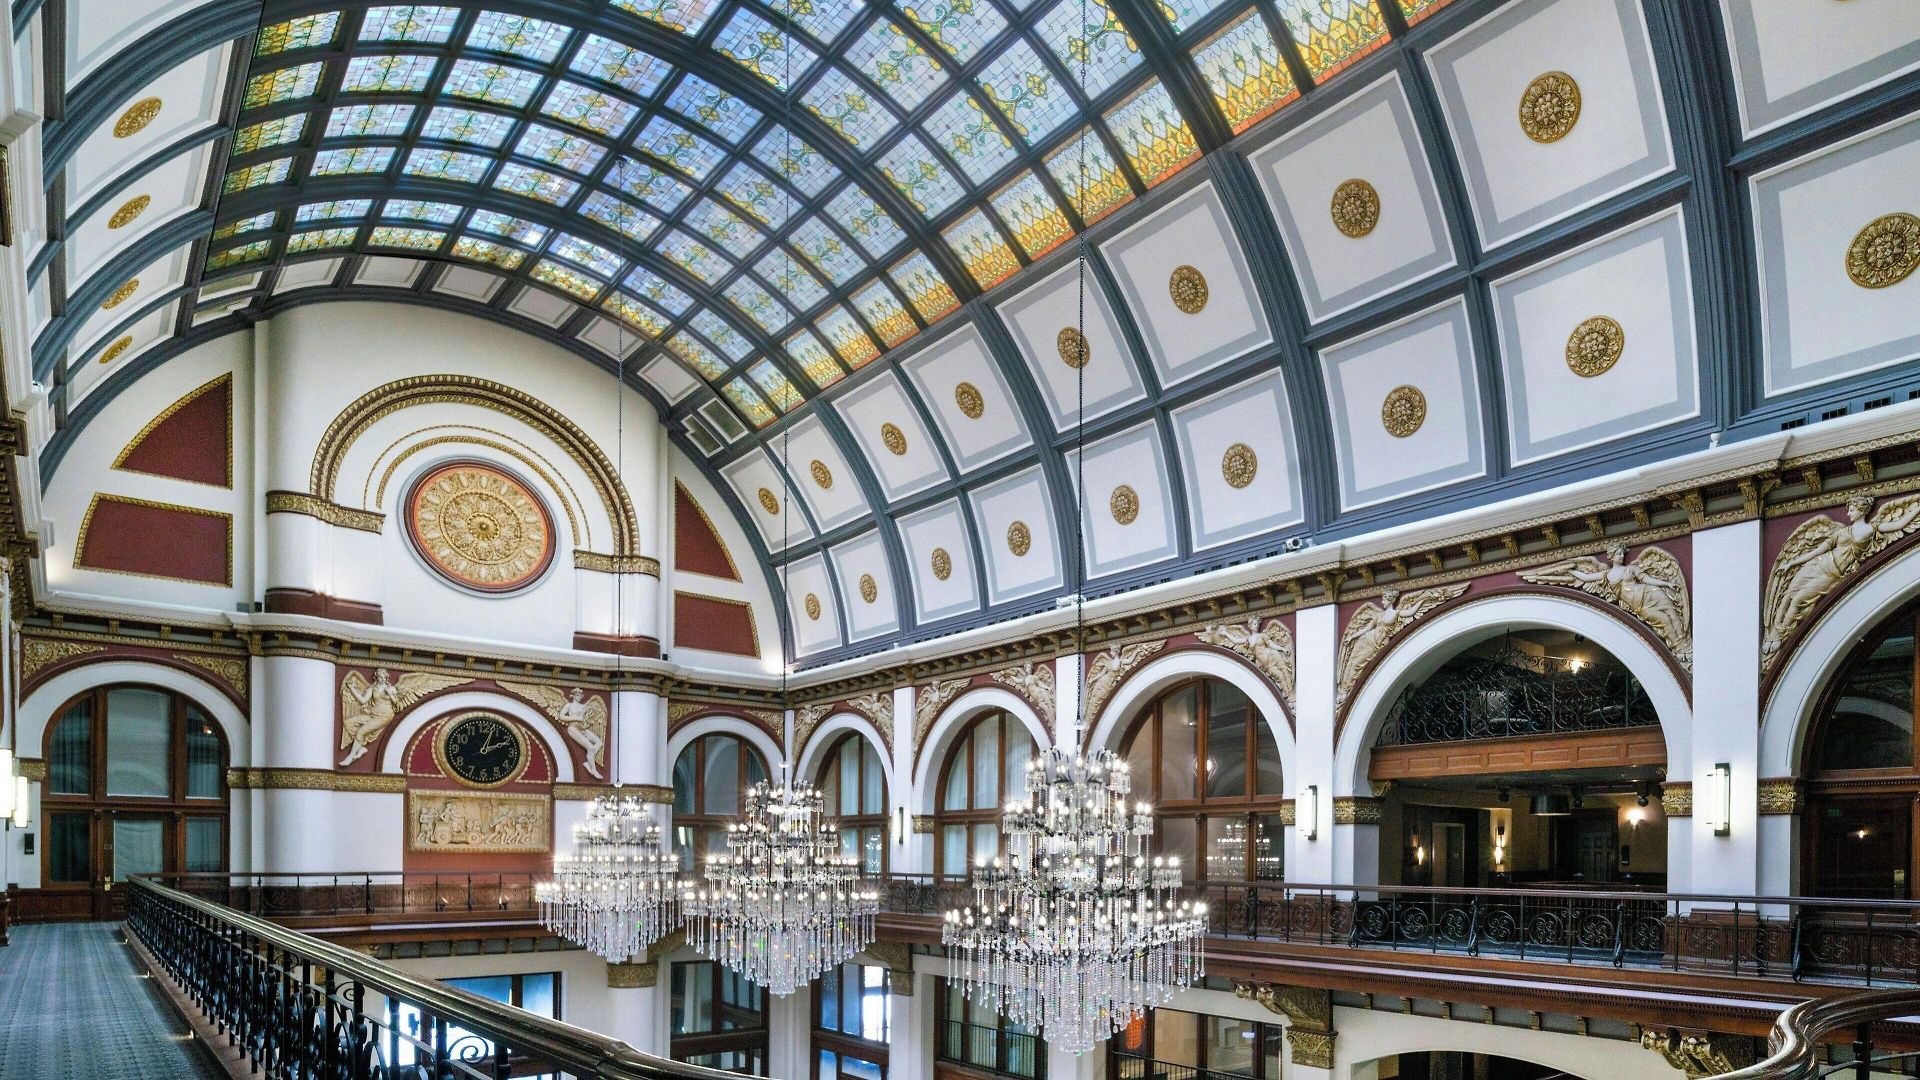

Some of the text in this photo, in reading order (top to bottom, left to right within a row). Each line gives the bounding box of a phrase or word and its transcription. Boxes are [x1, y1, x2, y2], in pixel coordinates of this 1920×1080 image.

[467, 726, 475, 736] 11
[478, 723, 490, 733] 12
[495, 728, 499, 736] 1
[457, 733, 468, 744] 10
[503, 736, 510, 745] 2
[452, 744, 459, 754] 9
[508, 748, 514, 757] 3
[456, 756, 463, 766] 8
[503, 760, 509, 768] 4
[468, 766, 475, 776] 7
[480, 769, 487, 779] 6
[493, 767, 500, 776] 5
